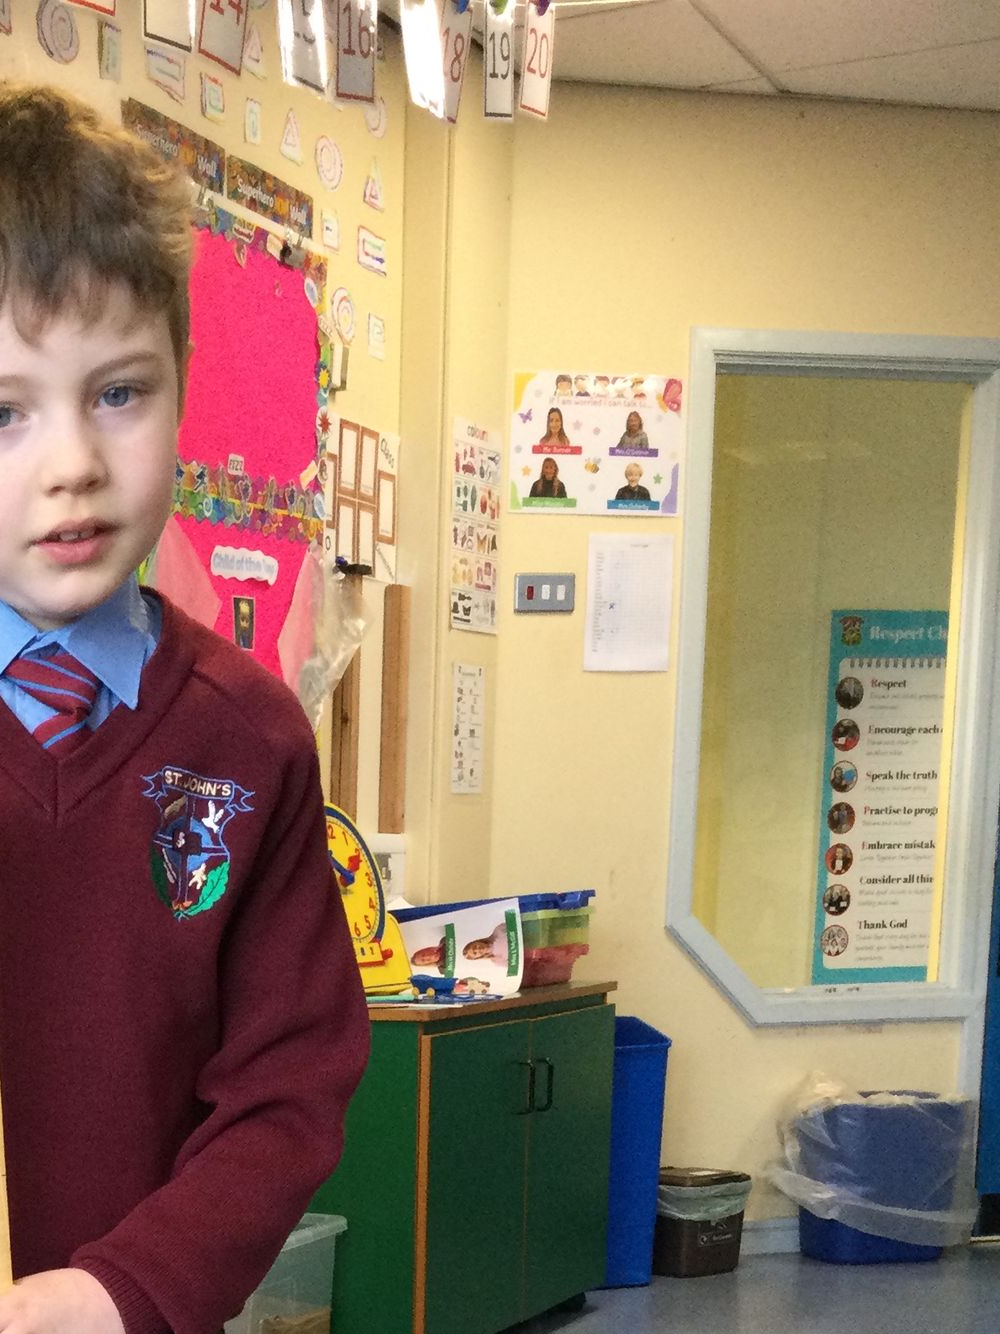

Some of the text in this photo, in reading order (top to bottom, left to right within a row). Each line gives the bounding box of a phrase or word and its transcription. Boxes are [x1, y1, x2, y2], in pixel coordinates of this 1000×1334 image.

[342, 4, 372, 58] 16
[443, 27, 465, 82] 18
[489, 32, 510, 79] 19
[527, 28, 548, 78] 20
[237, 178, 274, 208] Superhero
[869, 625, 924, 645] Respect
[871, 679, 906, 690] Respect
[868, 724, 916, 736] Encourage
[866, 770, 938, 783] Speak the truth
[183, 776, 231, 796] JOHN'S
[864, 805, 901, 816] Practise
[903, 806, 913, 815] to
[861, 840, 902, 850] Embrace
[365, 872, 373, 887] 3
[859, 874, 902, 885] Consider
[902, 874, 915, 884] all
[368, 897, 376, 910] 4
[354, 922, 361, 937] 6
[364, 915, 371, 930] 5
[858, 918, 908, 930] Thank God
